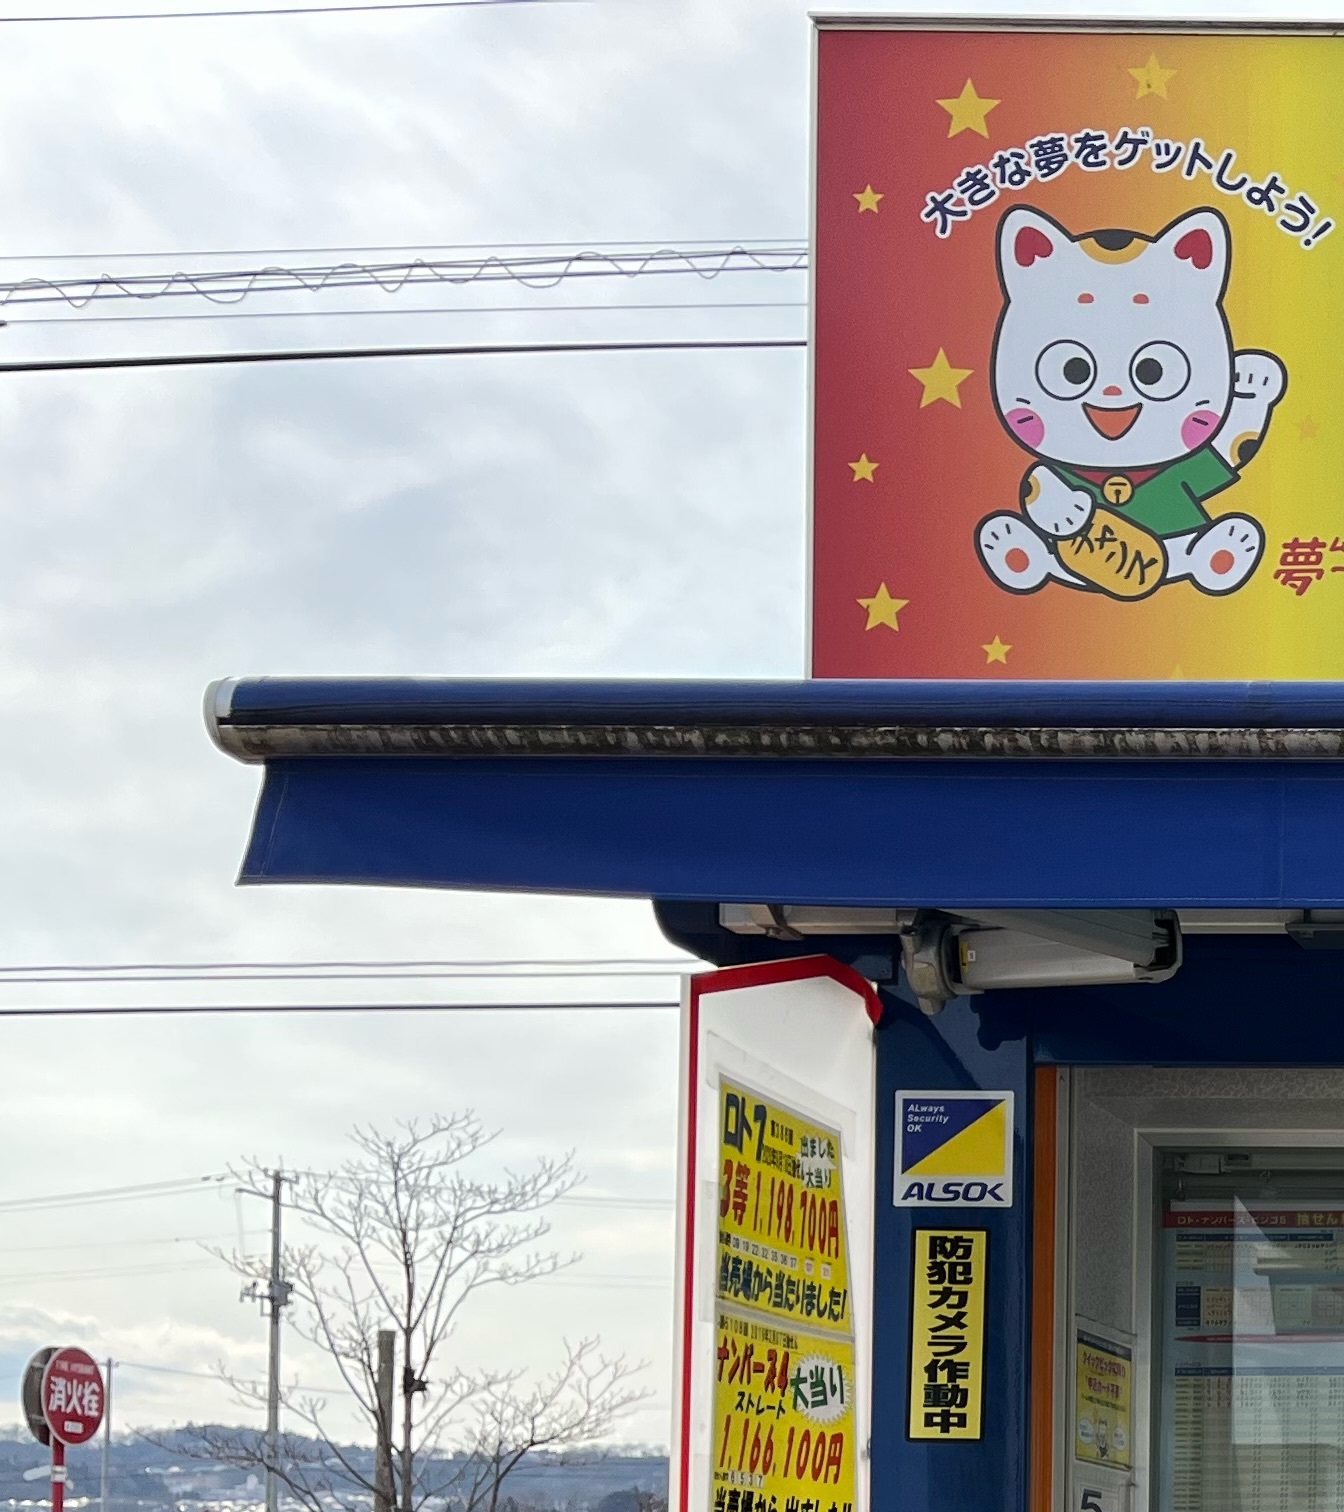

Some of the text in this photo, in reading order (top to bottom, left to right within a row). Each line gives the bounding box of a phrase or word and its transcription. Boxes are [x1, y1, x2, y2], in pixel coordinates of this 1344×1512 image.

[920, 128, 1337, 250] 大きな夢をゲットしよう!
[724, 1092, 767, 1162] ロト7
[908, 1104, 944, 1113] ALways
[908, 1114, 949, 1124] Security
[720, 1159, 751, 1225] 3等
[901, 1182, 1004, 1202] ALSOK
[721, 1252, 847, 1322] 当売場から当たりました!
[923, 1236, 973, 1433] 防犯カメラ作動中
[717, 1336, 789, 1397] ナンバーズ4
[790, 1365, 844, 1412] 大当り
[735, 1391, 785, 1419] ストレート
